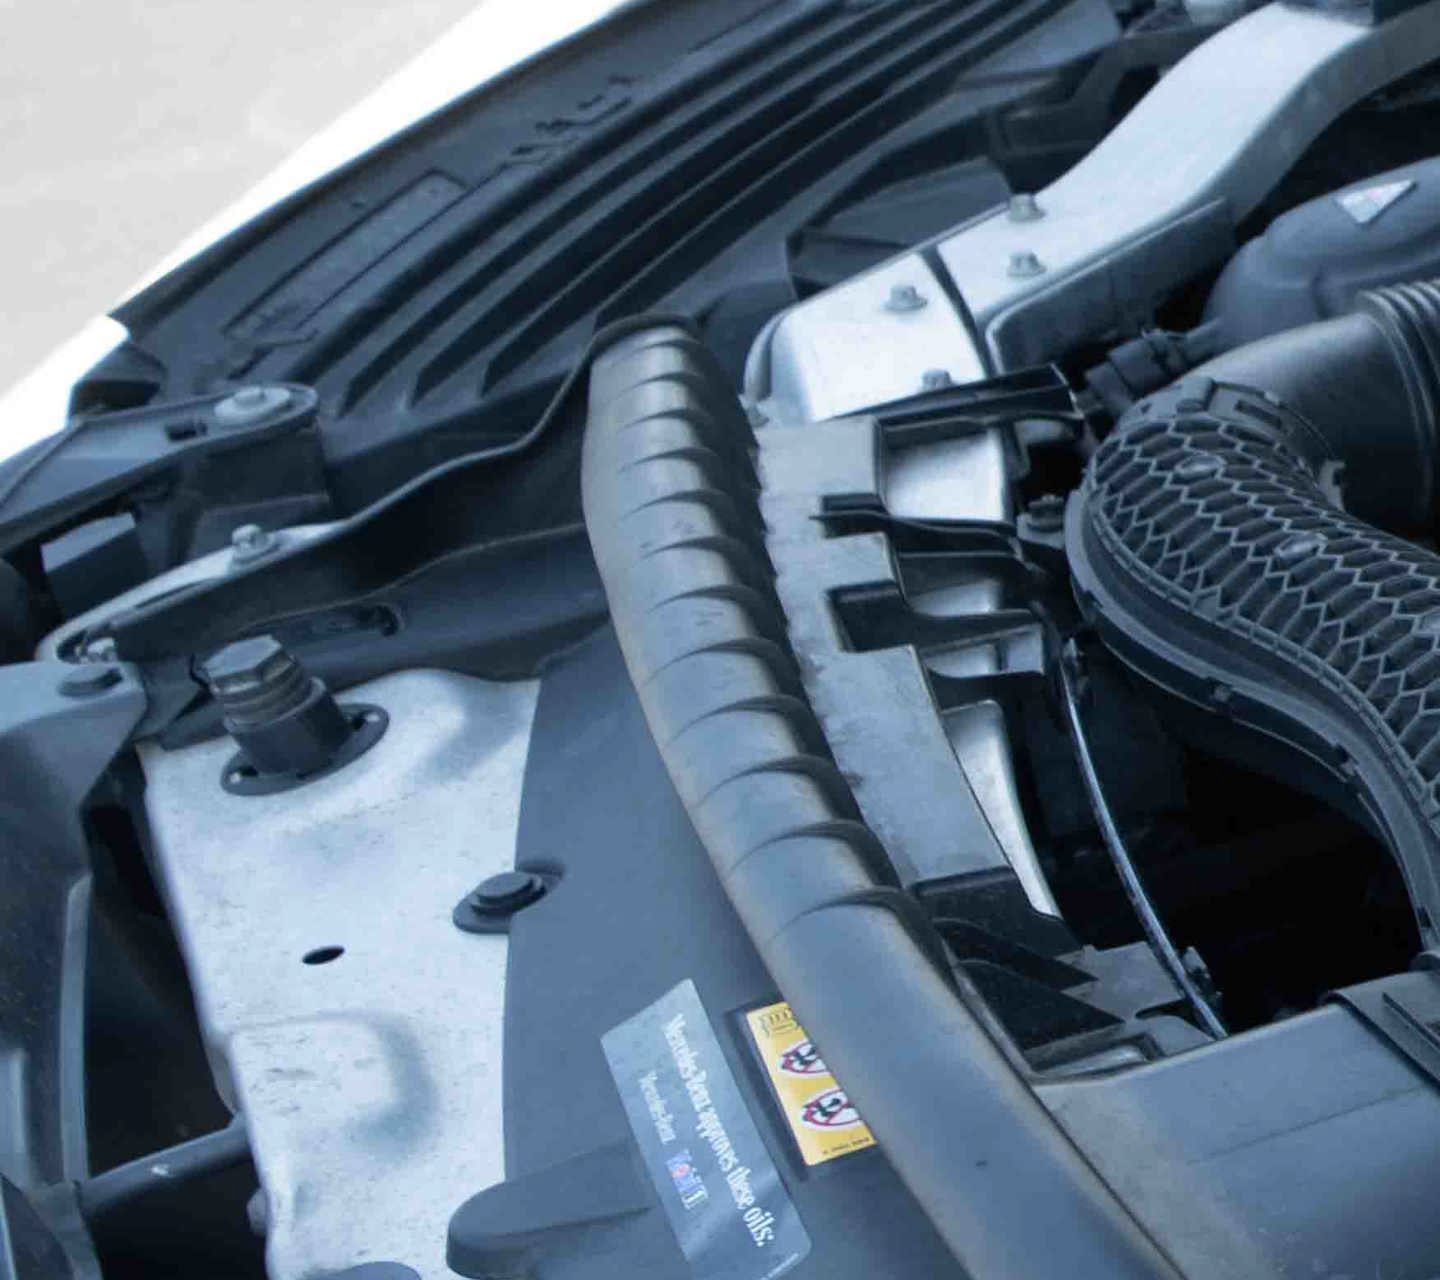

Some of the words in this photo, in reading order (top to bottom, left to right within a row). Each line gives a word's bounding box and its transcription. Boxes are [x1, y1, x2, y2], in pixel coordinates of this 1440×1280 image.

[696, 1107, 740, 1172] approves
[727, 1166, 757, 1211] these
[743, 1206, 777, 1248] oils:
